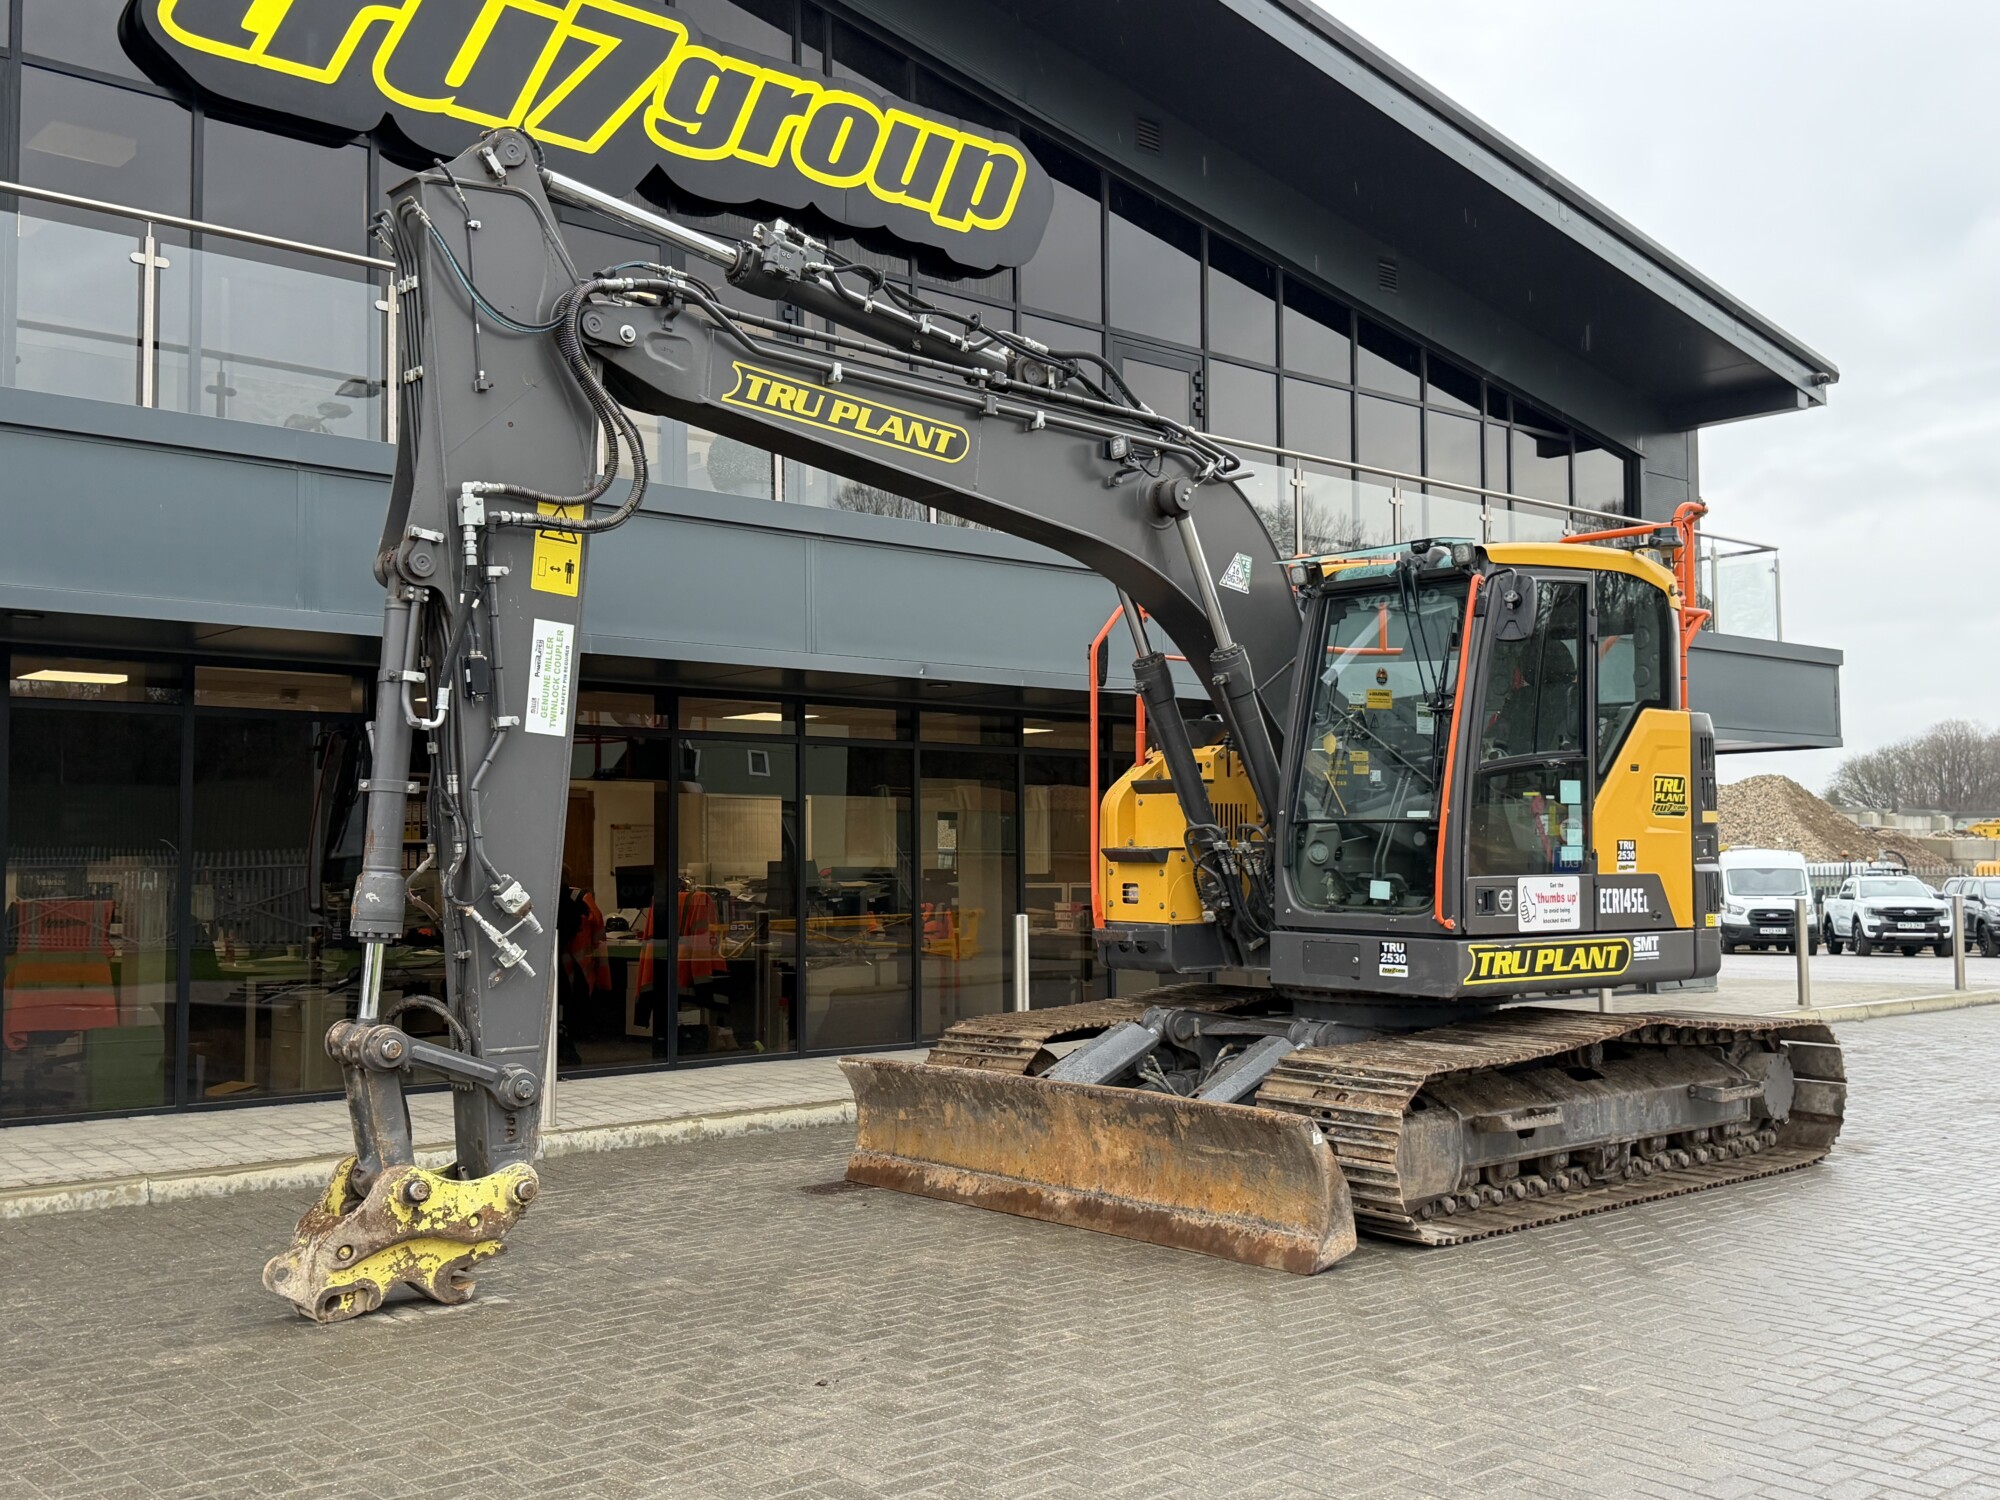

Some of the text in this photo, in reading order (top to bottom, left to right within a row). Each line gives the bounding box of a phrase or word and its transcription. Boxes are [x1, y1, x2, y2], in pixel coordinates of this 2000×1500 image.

[745, 373, 957, 455] TRU PLANT
[540, 636, 554, 719] GENUINE MILLER
[549, 629, 564, 728] TWINLOCK COUPLER
[1654, 778, 1684, 792] TRU
[1654, 793, 1684, 802] PLANT
[1618, 841, 1634, 850] TRU
[1618, 851, 1635, 860] 2530
[1381, 942, 1405, 953] TRU
[1633, 936, 1659, 952] SMT
[1380, 953, 1406, 964] 2530
[1477, 945, 1622, 976] TRU PLANT
